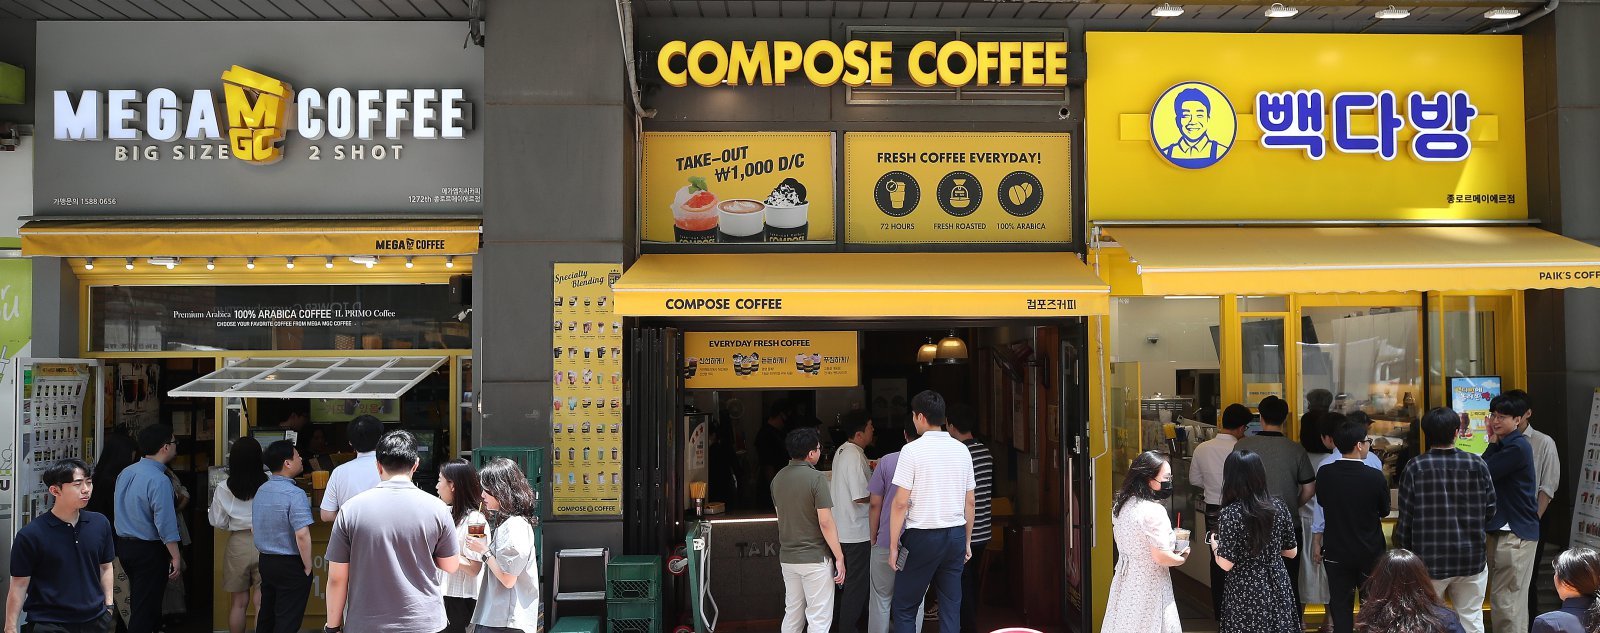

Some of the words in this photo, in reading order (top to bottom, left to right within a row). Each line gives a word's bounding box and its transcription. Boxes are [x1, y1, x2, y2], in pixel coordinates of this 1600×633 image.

[657, 39, 893, 87] COMPOSE
[908, 39, 1068, 87] COFFEE
[53, 88, 223, 141] MEGA
[297, 88, 468, 141] COFFEE
[1254, 90, 1478, 161] 백다방
[114, 145, 160, 161] BIG
[173, 145, 230, 161] SIZE
[309, 145, 321, 160] 2
[333, 145, 405, 161] SHOT
[676, 146, 748, 171] TAKE-OUT
[877, 152, 917, 164] FRESH
[920, 152, 966, 164] COFFEE
[969, 152, 1042, 165] EVERYDAY!
[779, 153, 806, 173] D/C
[408, 195, 432, 203] 1272th
[1447, 194, 1516, 204] 종로르메이에르점
[880, 222, 890, 230] 72
[891, 222, 916, 230] HOURS
[934, 222, 954, 230] FRESH
[955, 222, 987, 230] ROASTED
[997, 222, 1015, 230] 100%
[1016, 222, 1047, 230] ARABICA
[375, 239, 406, 250] MEGA
[416, 239, 445, 250] COFFEE
[554, 269, 589, 285] Specialty
[1539, 271, 1572, 281] PAIK'S
[571, 276, 605, 289] Blending
[665, 298, 730, 310] COMPOSE
[735, 298, 782, 310] COFFEE
[1027, 298, 1077, 310] 컴포즈커피
[173, 310, 204, 319] Premium
[205, 310, 232, 319] Arabica
[234, 309, 257, 319] 100%
[258, 309, 297, 319] ARABICA
[298, 309, 332, 319] COFFEE
[345, 309, 373, 318] PRIMO
[373, 309, 397, 318] Coffee
[709, 339, 753, 348] EVERYDAY
[753, 339, 779, 347] FRESH
[780, 338, 811, 347] COFFEE
